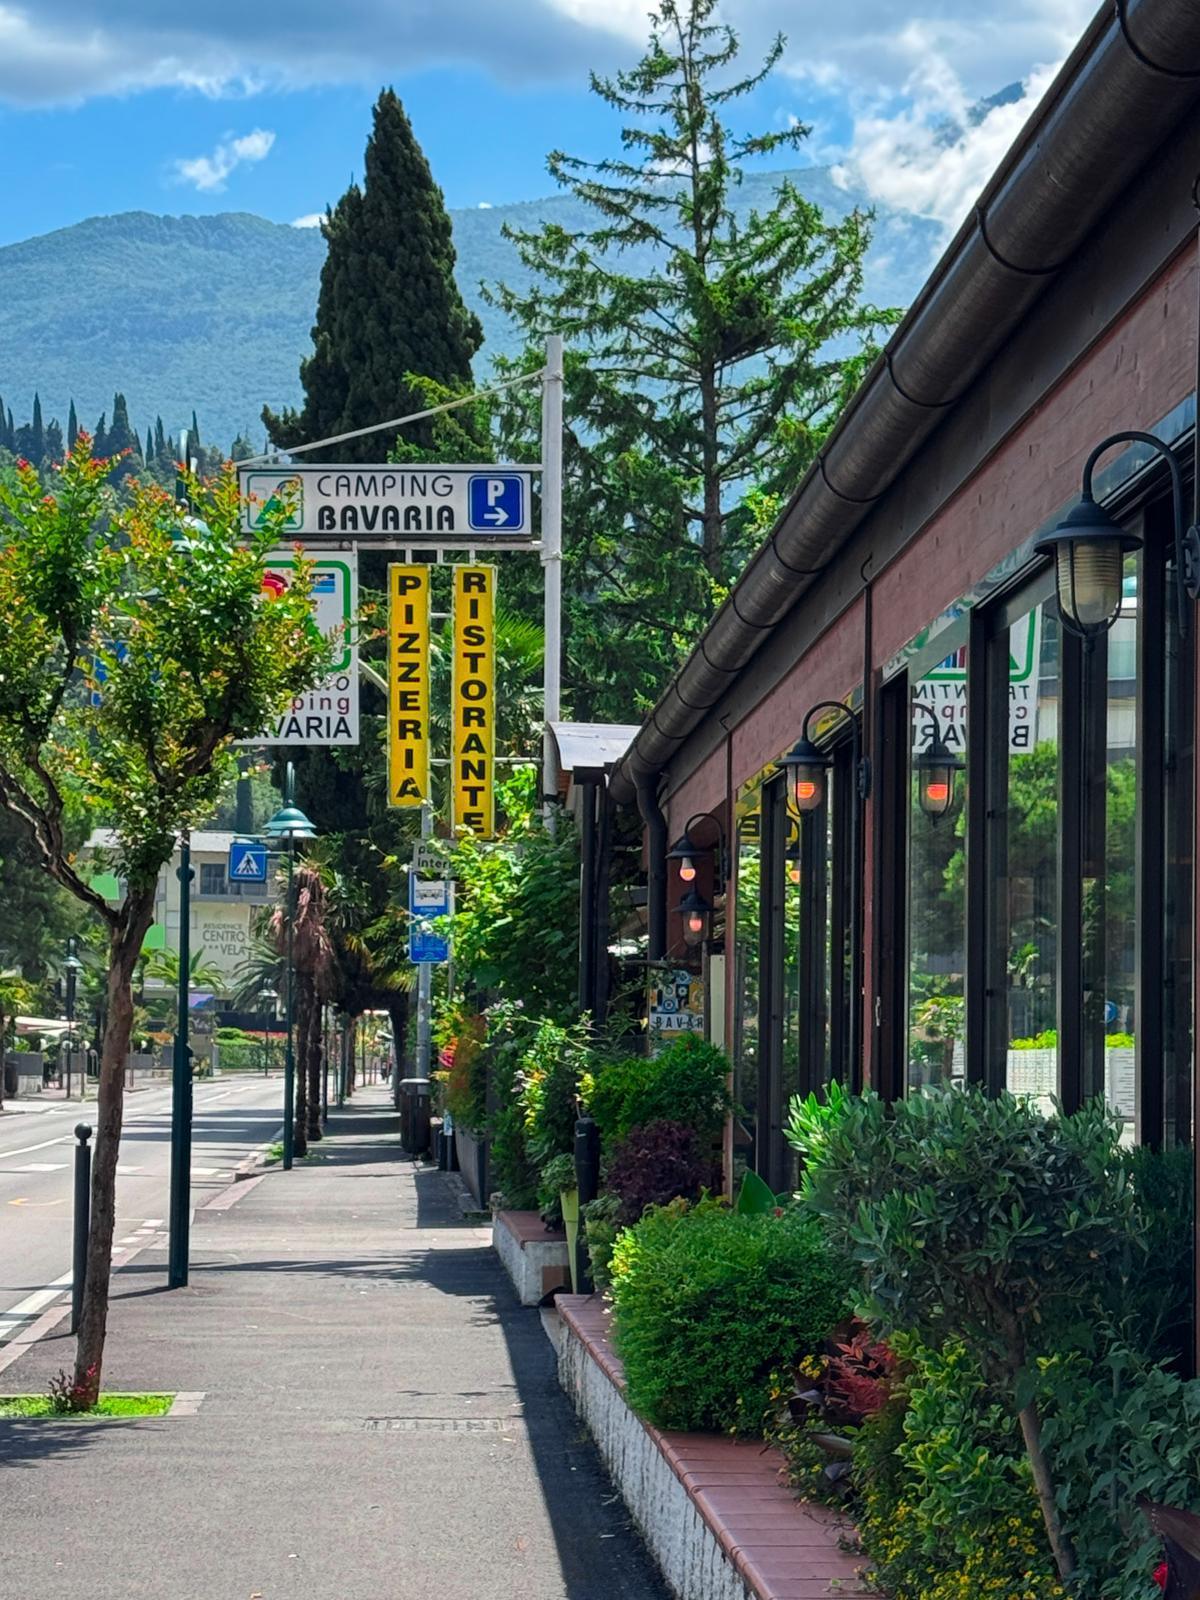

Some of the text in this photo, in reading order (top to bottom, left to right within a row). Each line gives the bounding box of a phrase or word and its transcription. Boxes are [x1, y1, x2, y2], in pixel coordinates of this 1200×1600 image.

[317, 474, 453, 497] CAMPING
[487, 479, 505, 506] P
[317, 504, 455, 531] BAVARIA
[396, 575, 422, 798] PIZZERIA
[291, 693, 350, 715] ping
[460, 572, 488, 833] RISTORANTE
[203, 930, 245, 942] CENTRO
